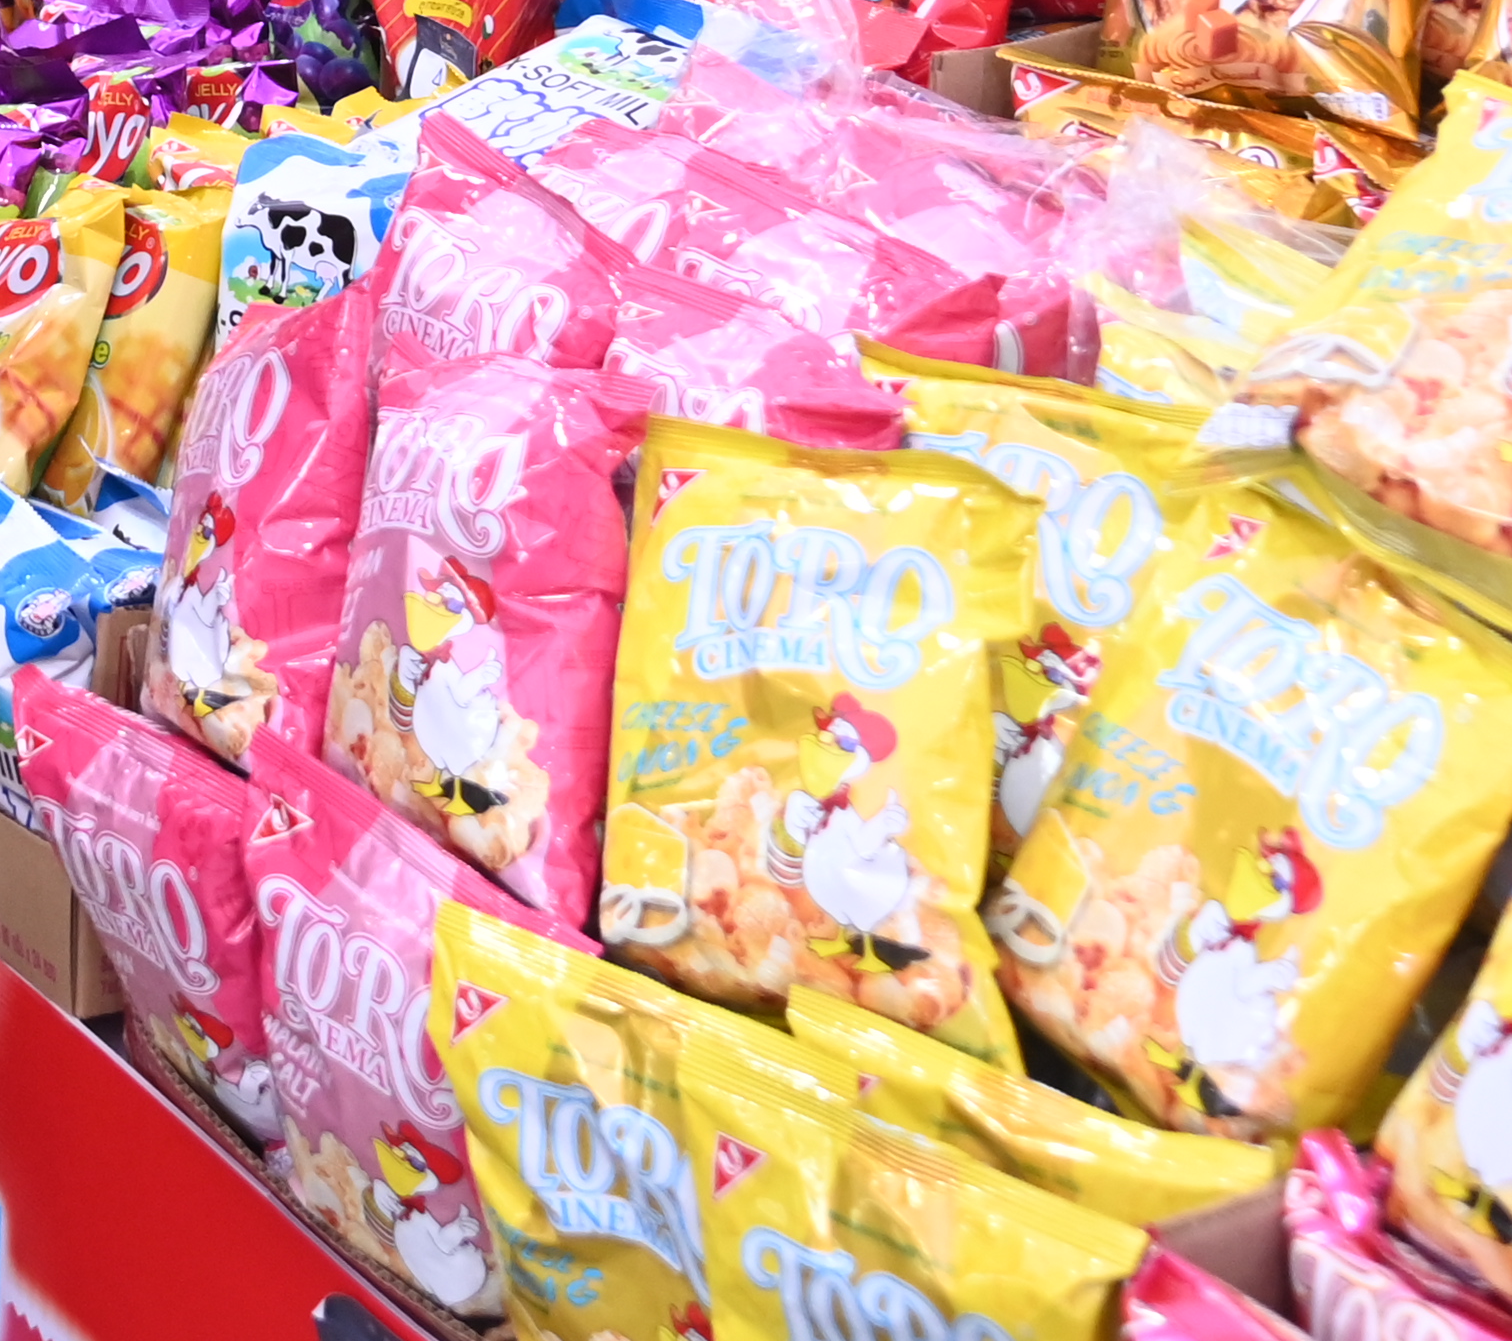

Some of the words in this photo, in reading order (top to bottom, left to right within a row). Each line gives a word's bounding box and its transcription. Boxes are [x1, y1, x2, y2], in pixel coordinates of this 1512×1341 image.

[195, 82, 239, 97] JELLY
[506, 56, 608, 100] X-SOFT
[595, 91, 651, 127] MIL
[4, 225, 45, 240] JELLY
[127, 224, 147, 240] LLY
[380, 217, 570, 361] TORO
[662, 520, 956, 690] TORO
[697, 631, 830, 674] CINEMA
[1155, 572, 1445, 850] TORO
[34, 794, 221, 995] TORO
[257, 873, 464, 1130] TORO
[478, 1067, 709, 1307] TOR
